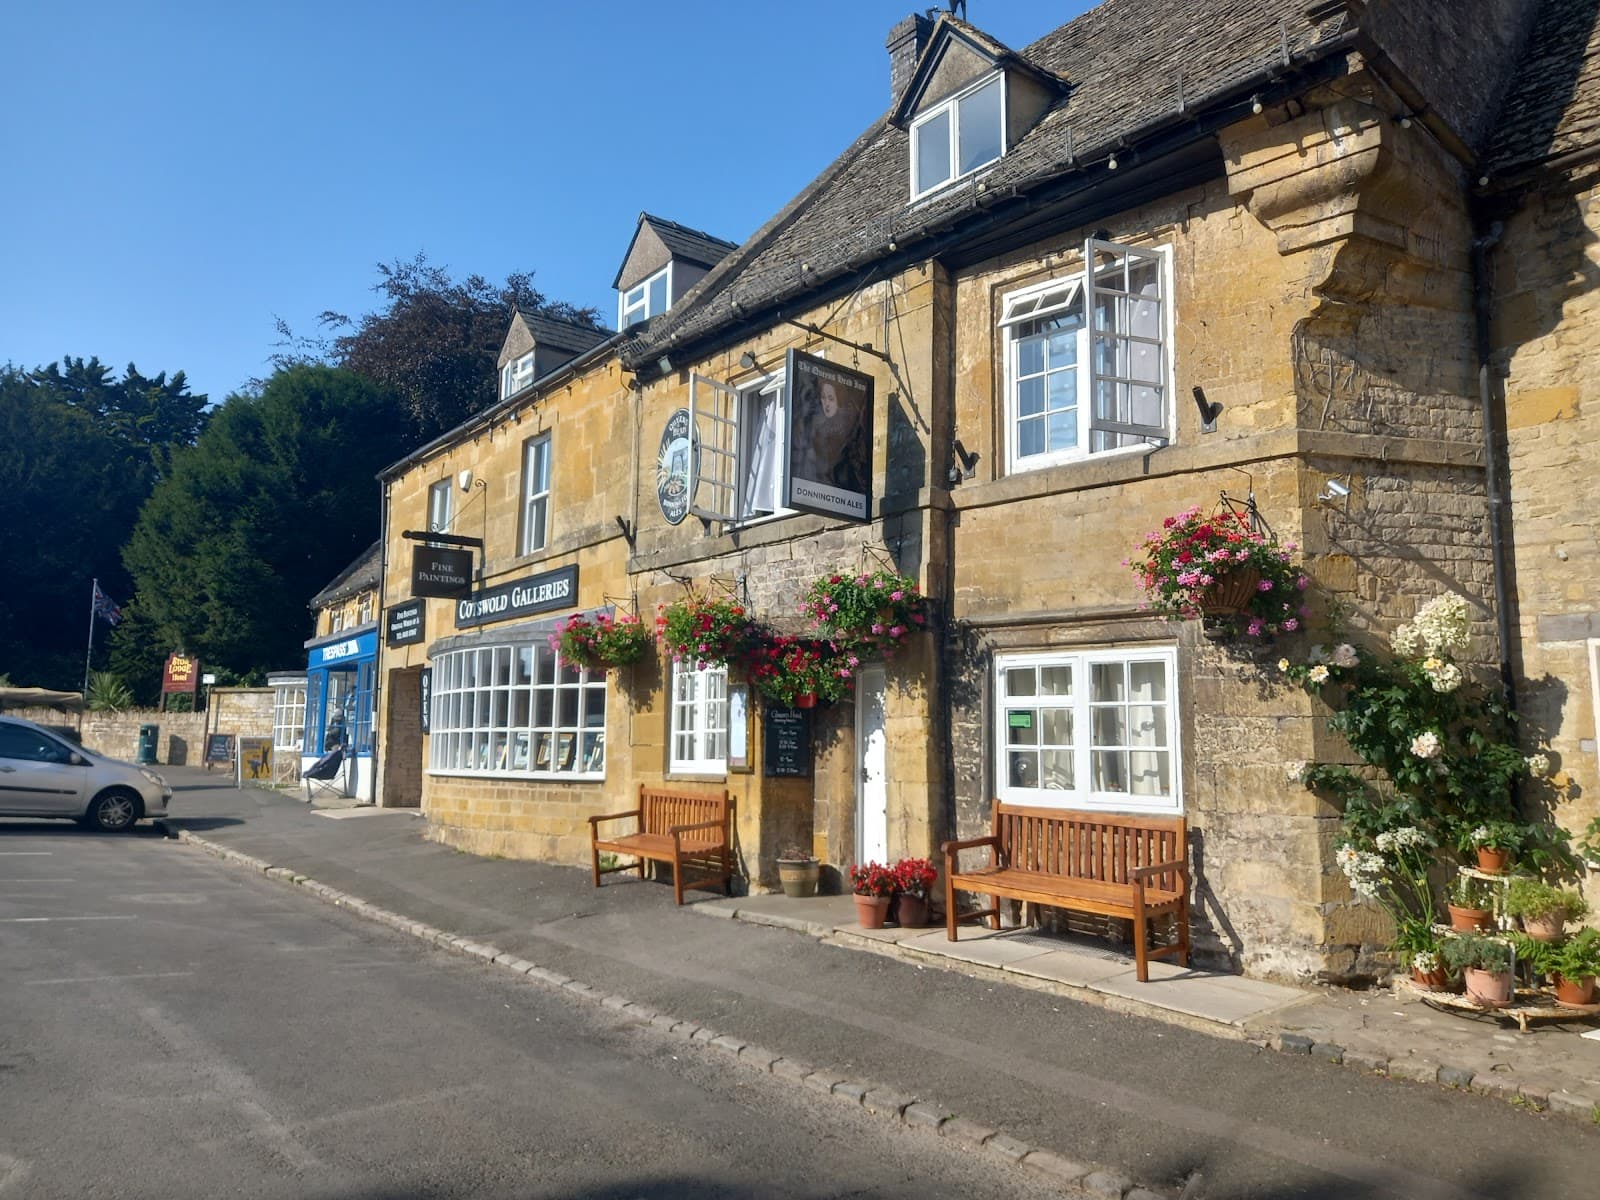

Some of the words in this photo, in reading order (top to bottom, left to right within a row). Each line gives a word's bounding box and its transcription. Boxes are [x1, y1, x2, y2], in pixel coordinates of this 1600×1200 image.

[796, 487, 846, 506] DONNINGTON
[847, 499, 864, 510] ALES
[670, 508, 682, 517] ALES
[418, 571, 466, 585] PAINTINGS
[460, 595, 507, 619] COTSWOLD
[511, 578, 570, 608] GALLERIES
